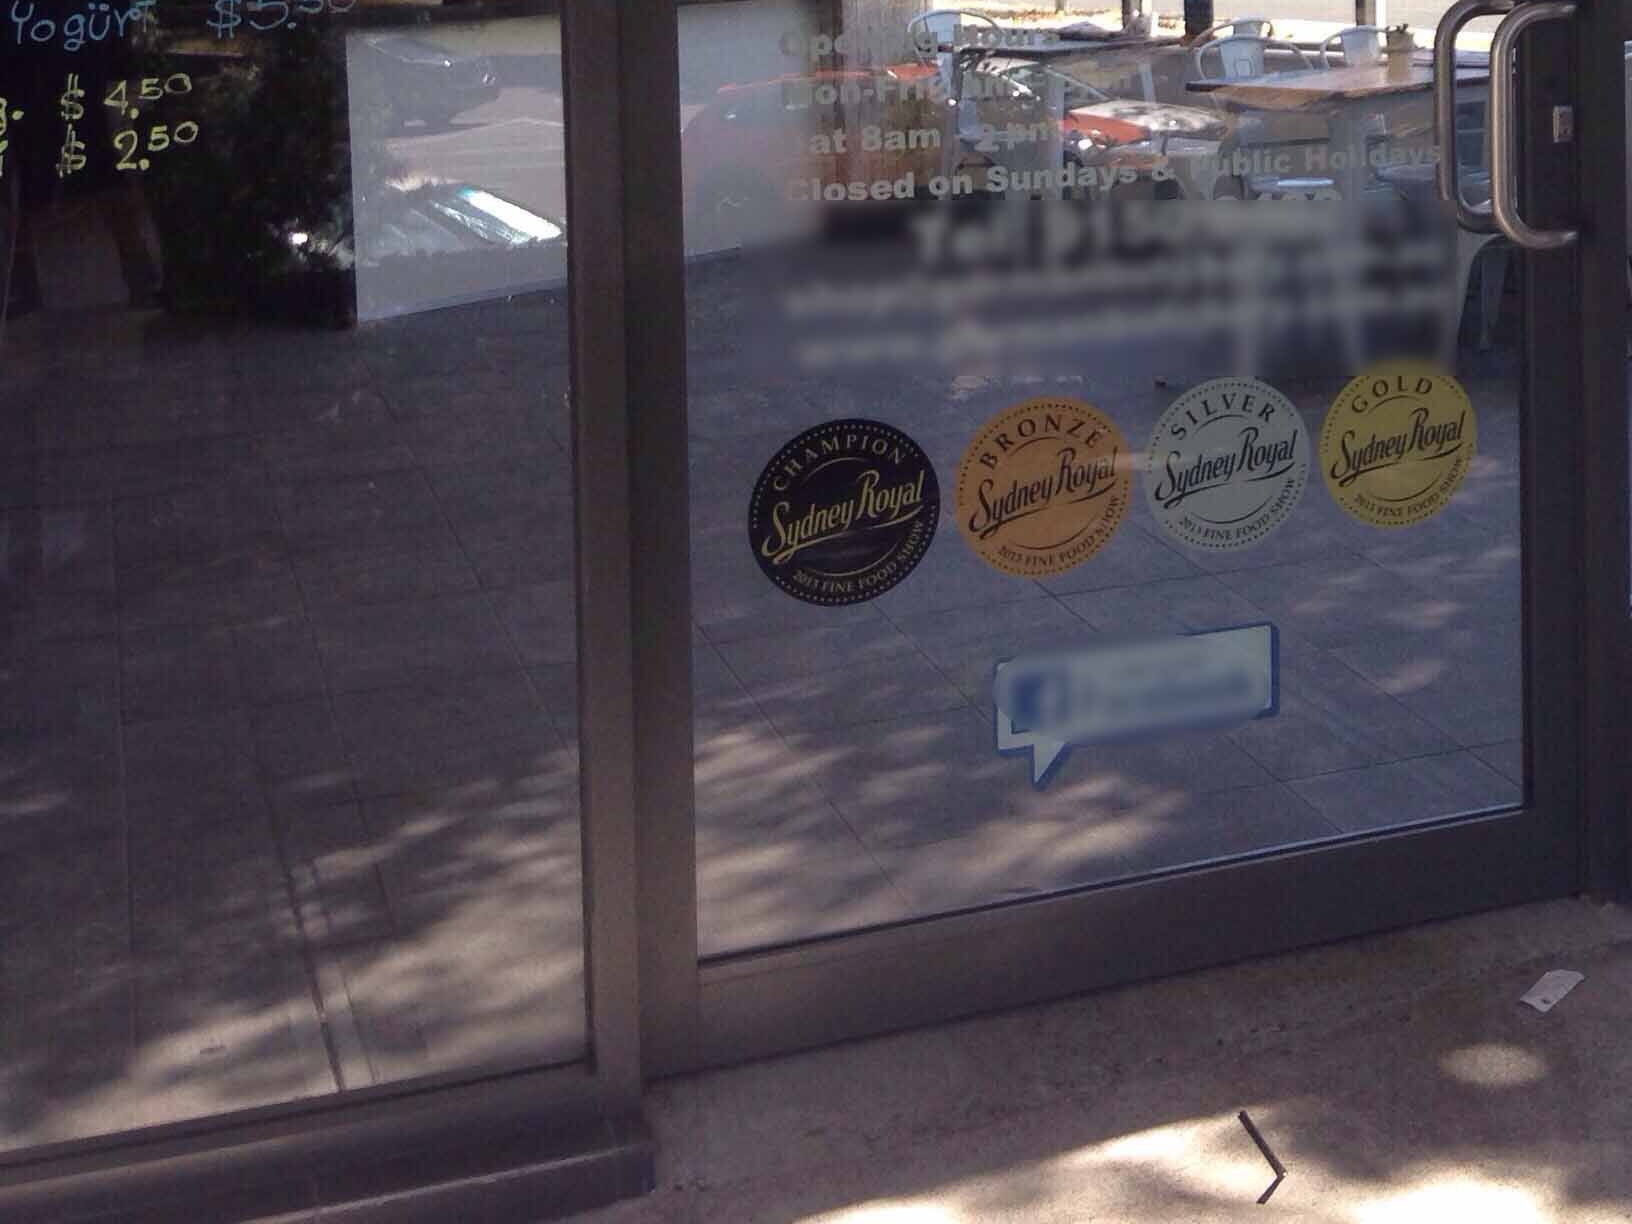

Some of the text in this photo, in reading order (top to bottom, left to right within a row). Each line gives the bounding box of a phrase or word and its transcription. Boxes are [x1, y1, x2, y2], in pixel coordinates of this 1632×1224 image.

[103, 73, 193, 120] 4.50
[113, 121, 200, 172] 2.50
[809, 129, 848, 154] at
[861, 126, 942, 152] 8am
[784, 172, 915, 201] Closed
[929, 174, 974, 196] on
[986, 161, 1139, 193] Sundays
[1303, 142, 1442, 170] Holidays
[1170, 392, 1275, 441] SILVER
[1352, 376, 1433, 413] GOLD
[773, 434, 905, 492] CHAMPION
[979, 413, 1105, 470] BRONZE
[1154, 426, 1298, 510] Sydney Royal
[1330, 407, 1467, 487] Sydney Royal
[761, 469, 926, 565] Sydney Royal
[968, 445, 1119, 540] Sydney Royal
